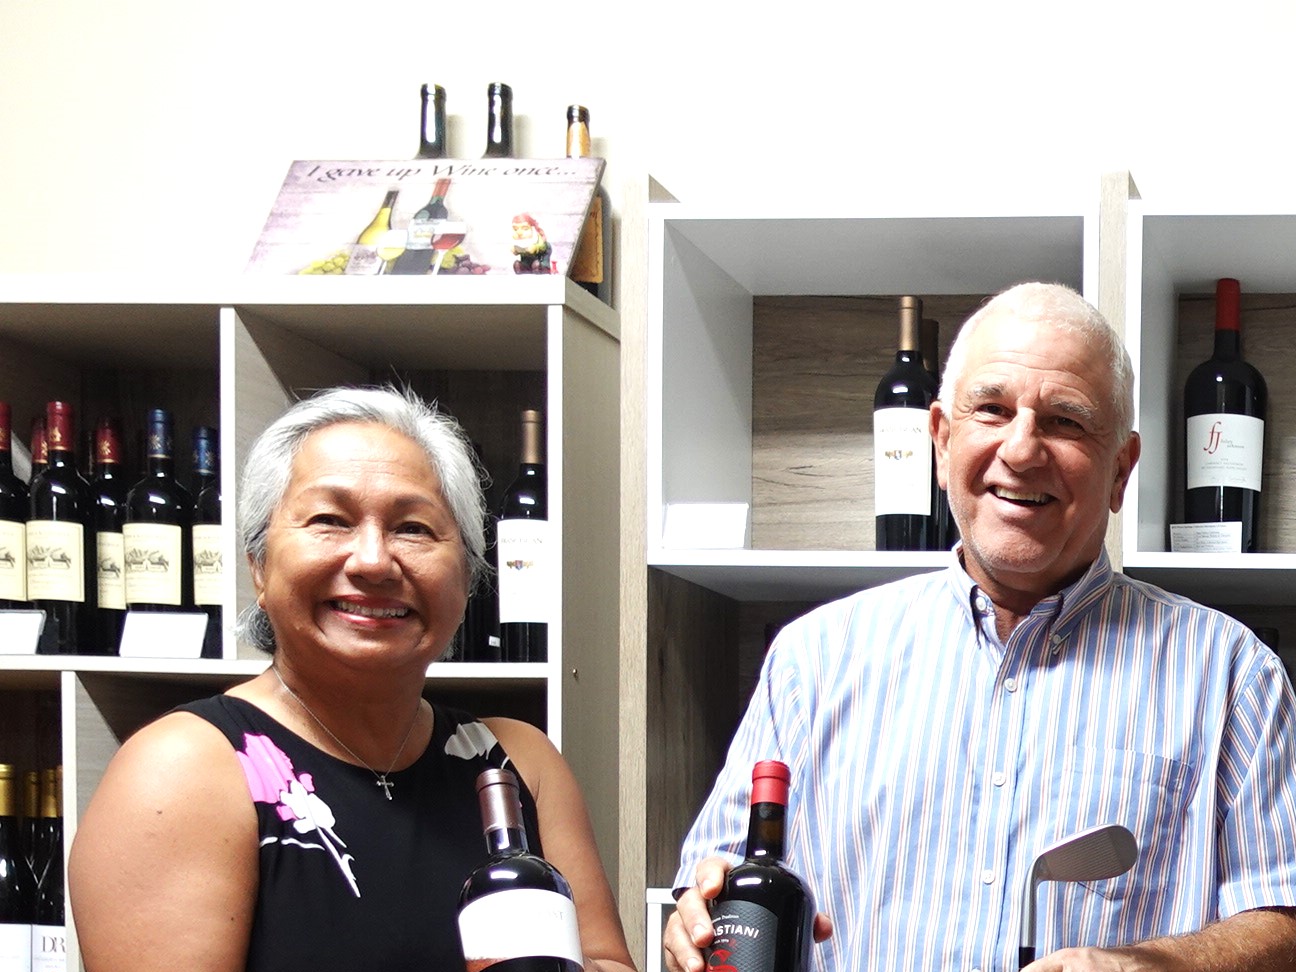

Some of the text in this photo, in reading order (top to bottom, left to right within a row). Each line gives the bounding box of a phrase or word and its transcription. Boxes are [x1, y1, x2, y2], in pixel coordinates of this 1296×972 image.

[307, 165, 321, 177] I
[317, 166, 380, 182] gave
[386, 167, 421, 181] up
[432, 164, 499, 177] Wine
